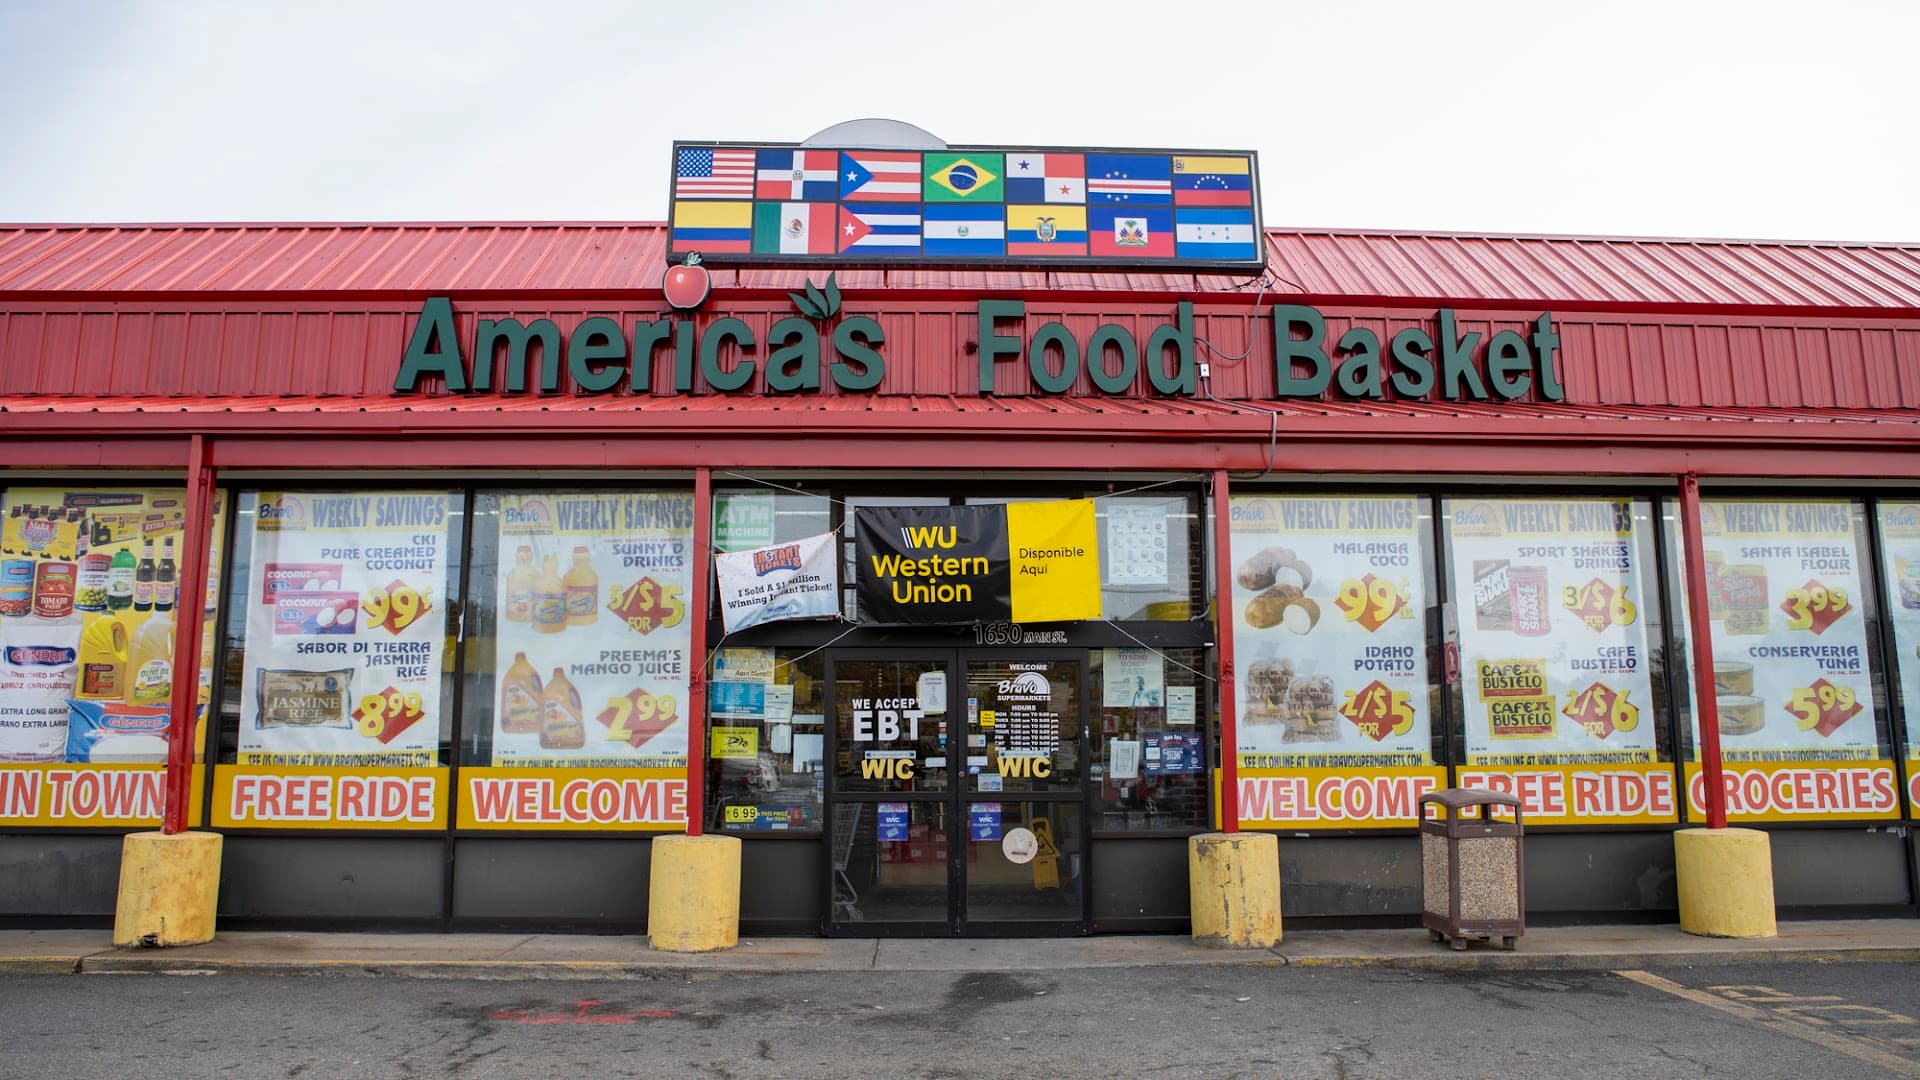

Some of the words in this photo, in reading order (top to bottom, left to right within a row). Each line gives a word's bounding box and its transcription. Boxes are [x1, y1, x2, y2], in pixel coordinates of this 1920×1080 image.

[977, 300, 1195, 395] Food
[1273, 304, 1565, 400] Basket
[312, 498, 370, 528] WEEKLY
[376, 496, 444, 527] SAVINGS
[504, 507, 539, 523] Bravo
[556, 500, 617, 530] WEEKLY
[624, 499, 693, 529] SAVINGS
[719, 505, 769, 524] ATM
[1231, 506, 1264, 521] Bravo
[1281, 500, 1342, 529] WEEKLY
[1348, 500, 1413, 529] SAVINGS
[1502, 503, 1561, 532] WEEKLY
[1568, 503, 1632, 532] SAVINGS
[1723, 505, 1782, 533] WEEKLY
[1786, 505, 1849, 532] SAVINGS
[718, 528, 769, 536] MACHINE
[903, 526, 957, 549] WU
[412, 535, 436, 546] CKI
[321, 548, 360, 560] PURE
[365, 547, 436, 559] CREAMED
[613, 544, 665, 555] SUNNY
[673, 544, 683, 555] D
[1019, 547, 1084, 560] Disponible
[1333, 543, 1408, 554] MALANGA
[1518, 546, 1567, 558] SPORT
[1572, 545, 1628, 557] SHAKES
[1741, 547, 1791, 558] SANTA
[1797, 547, 1849, 557] ISABEL
[366, 558, 435, 570] COCONUT
[623, 555, 684, 568] DRINKS
[756, 558, 801, 574] TICKETS
[871, 555, 989, 578] Western
[1370, 555, 1408, 566] COCO
[1574, 558, 1629, 569] DRINKS
[1802, 559, 1850, 570] FLOUR
[745, 586, 764, 596] Sold
[767, 584, 773, 592] A
[776, 581, 785, 591] $1
[892, 579, 972, 603] Union
[728, 594, 767, 609] Winning
[769, 587, 798, 602] Inant
[800, 583, 832, 593] Ticket!
[627, 616, 650, 631] FOR
[1584, 615, 1604, 628] FOR
[973, 624, 1022, 645] 1650
[1023, 631, 1051, 643] MAIN
[1052, 631, 1067, 643] ST.
[297, 642, 347, 654] SABOR
[353, 642, 368, 653] DI
[374, 641, 431, 653] TIERRA
[1365, 646, 1414, 658] IDAHO
[1597, 646, 1635, 657] CAFE
[1750, 646, 1858, 657] CONSERVERIA
[366, 654, 430, 667] JASMINE
[600, 650, 681, 662] PREEMA'S
[571, 663, 631, 675] MANGO
[638, 662, 681, 675] JUICE
[1354, 659, 1415, 671] POTATO
[1571, 659, 1636, 671] BUSTELO
[1816, 658, 1860, 669] TUNA
[397, 666, 427, 677] RICE
[997, 680, 1037, 693] Bravo
[1483, 675, 1542, 688] BUSTELO
[273, 697, 339, 708] JASMINE
[852, 698, 870, 709] WE
[289, 709, 322, 718] RICE
[1493, 713, 1551, 726] BUSTELO
[853, 710, 924, 741] EBT
[1358, 722, 1379, 736] FOR
[1584, 721, 1605, 735] FOR
[997, 757, 1050, 778] WIC
[1244, 756, 1256, 768] SEE
[1258, 756, 1266, 768] US
[1268, 755, 1294, 768] ONLINE
[1296, 755, 1306, 768] AT
[861, 759, 914, 780] WIC
[0, 772, 40, 817] IN
[48, 771, 167, 818] TOWN
[233, 777, 331, 818] FREE
[338, 778, 433, 820] RIDE
[471, 779, 688, 821] WELCOME
[1238, 779, 1435, 819] WELCOME
[1464, 774, 1565, 813] FREE
[1575, 774, 1672, 813] RIDE
